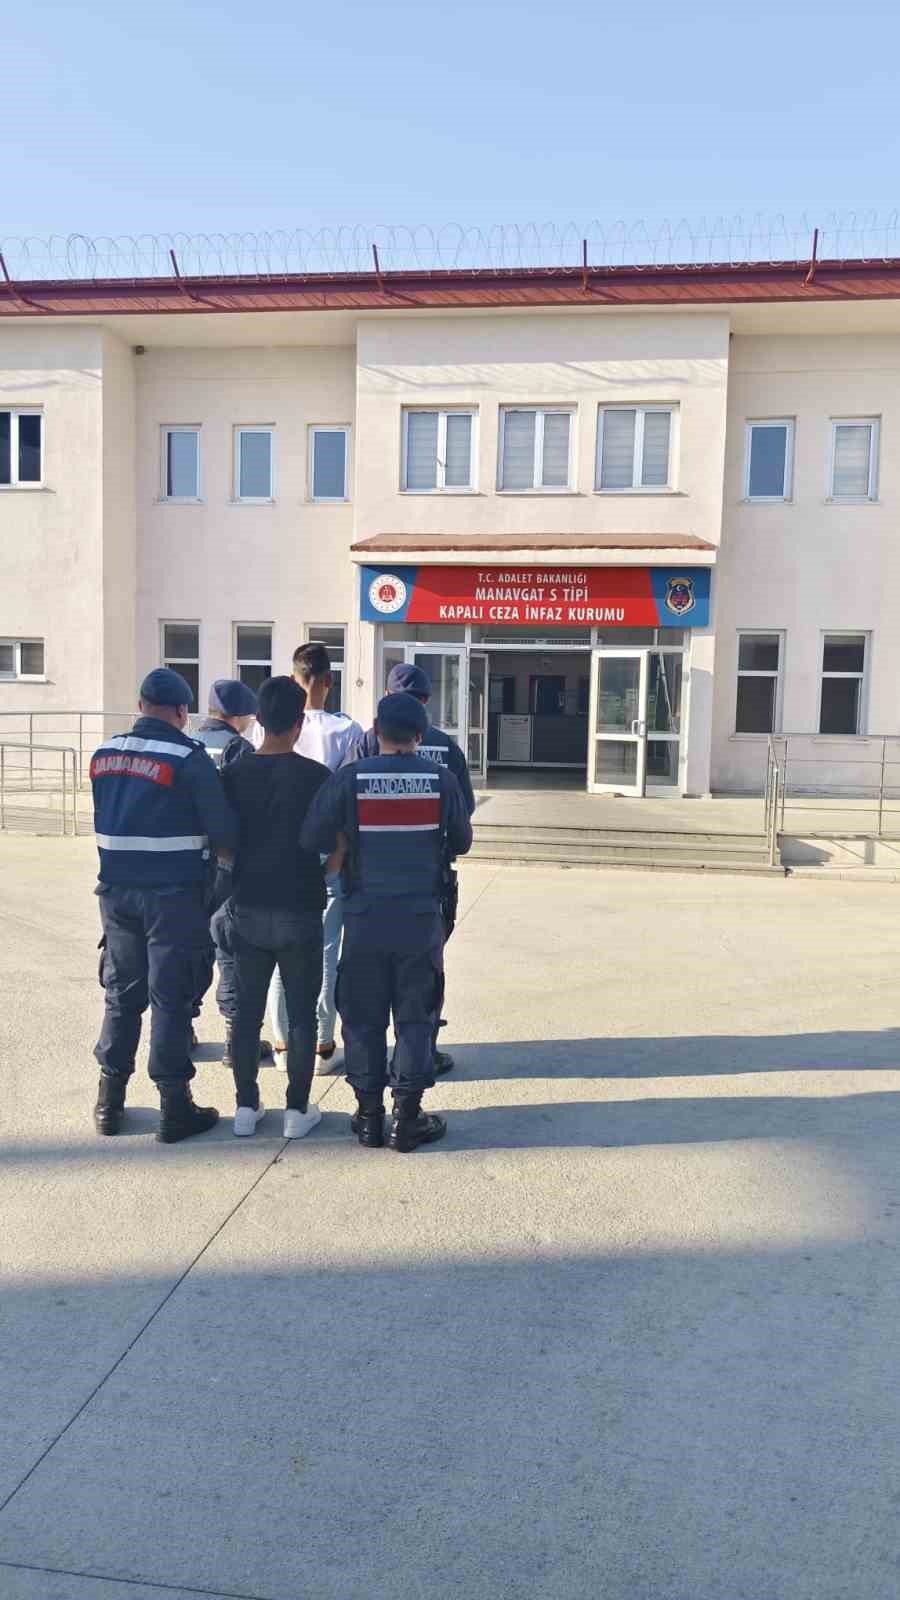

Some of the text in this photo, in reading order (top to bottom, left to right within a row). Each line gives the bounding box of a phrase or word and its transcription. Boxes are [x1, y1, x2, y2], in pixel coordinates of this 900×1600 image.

[478, 573, 495, 583] T.C.
[498, 573, 533, 584] ADALET
[475, 585, 589, 602] MANAVGAT S TİPİ
[439, 604, 625, 621] KAPALI CEZA İNFAZ KURUMU
[95, 755, 161, 778] JANDARMA
[364, 778, 433, 794] JANDARMA
